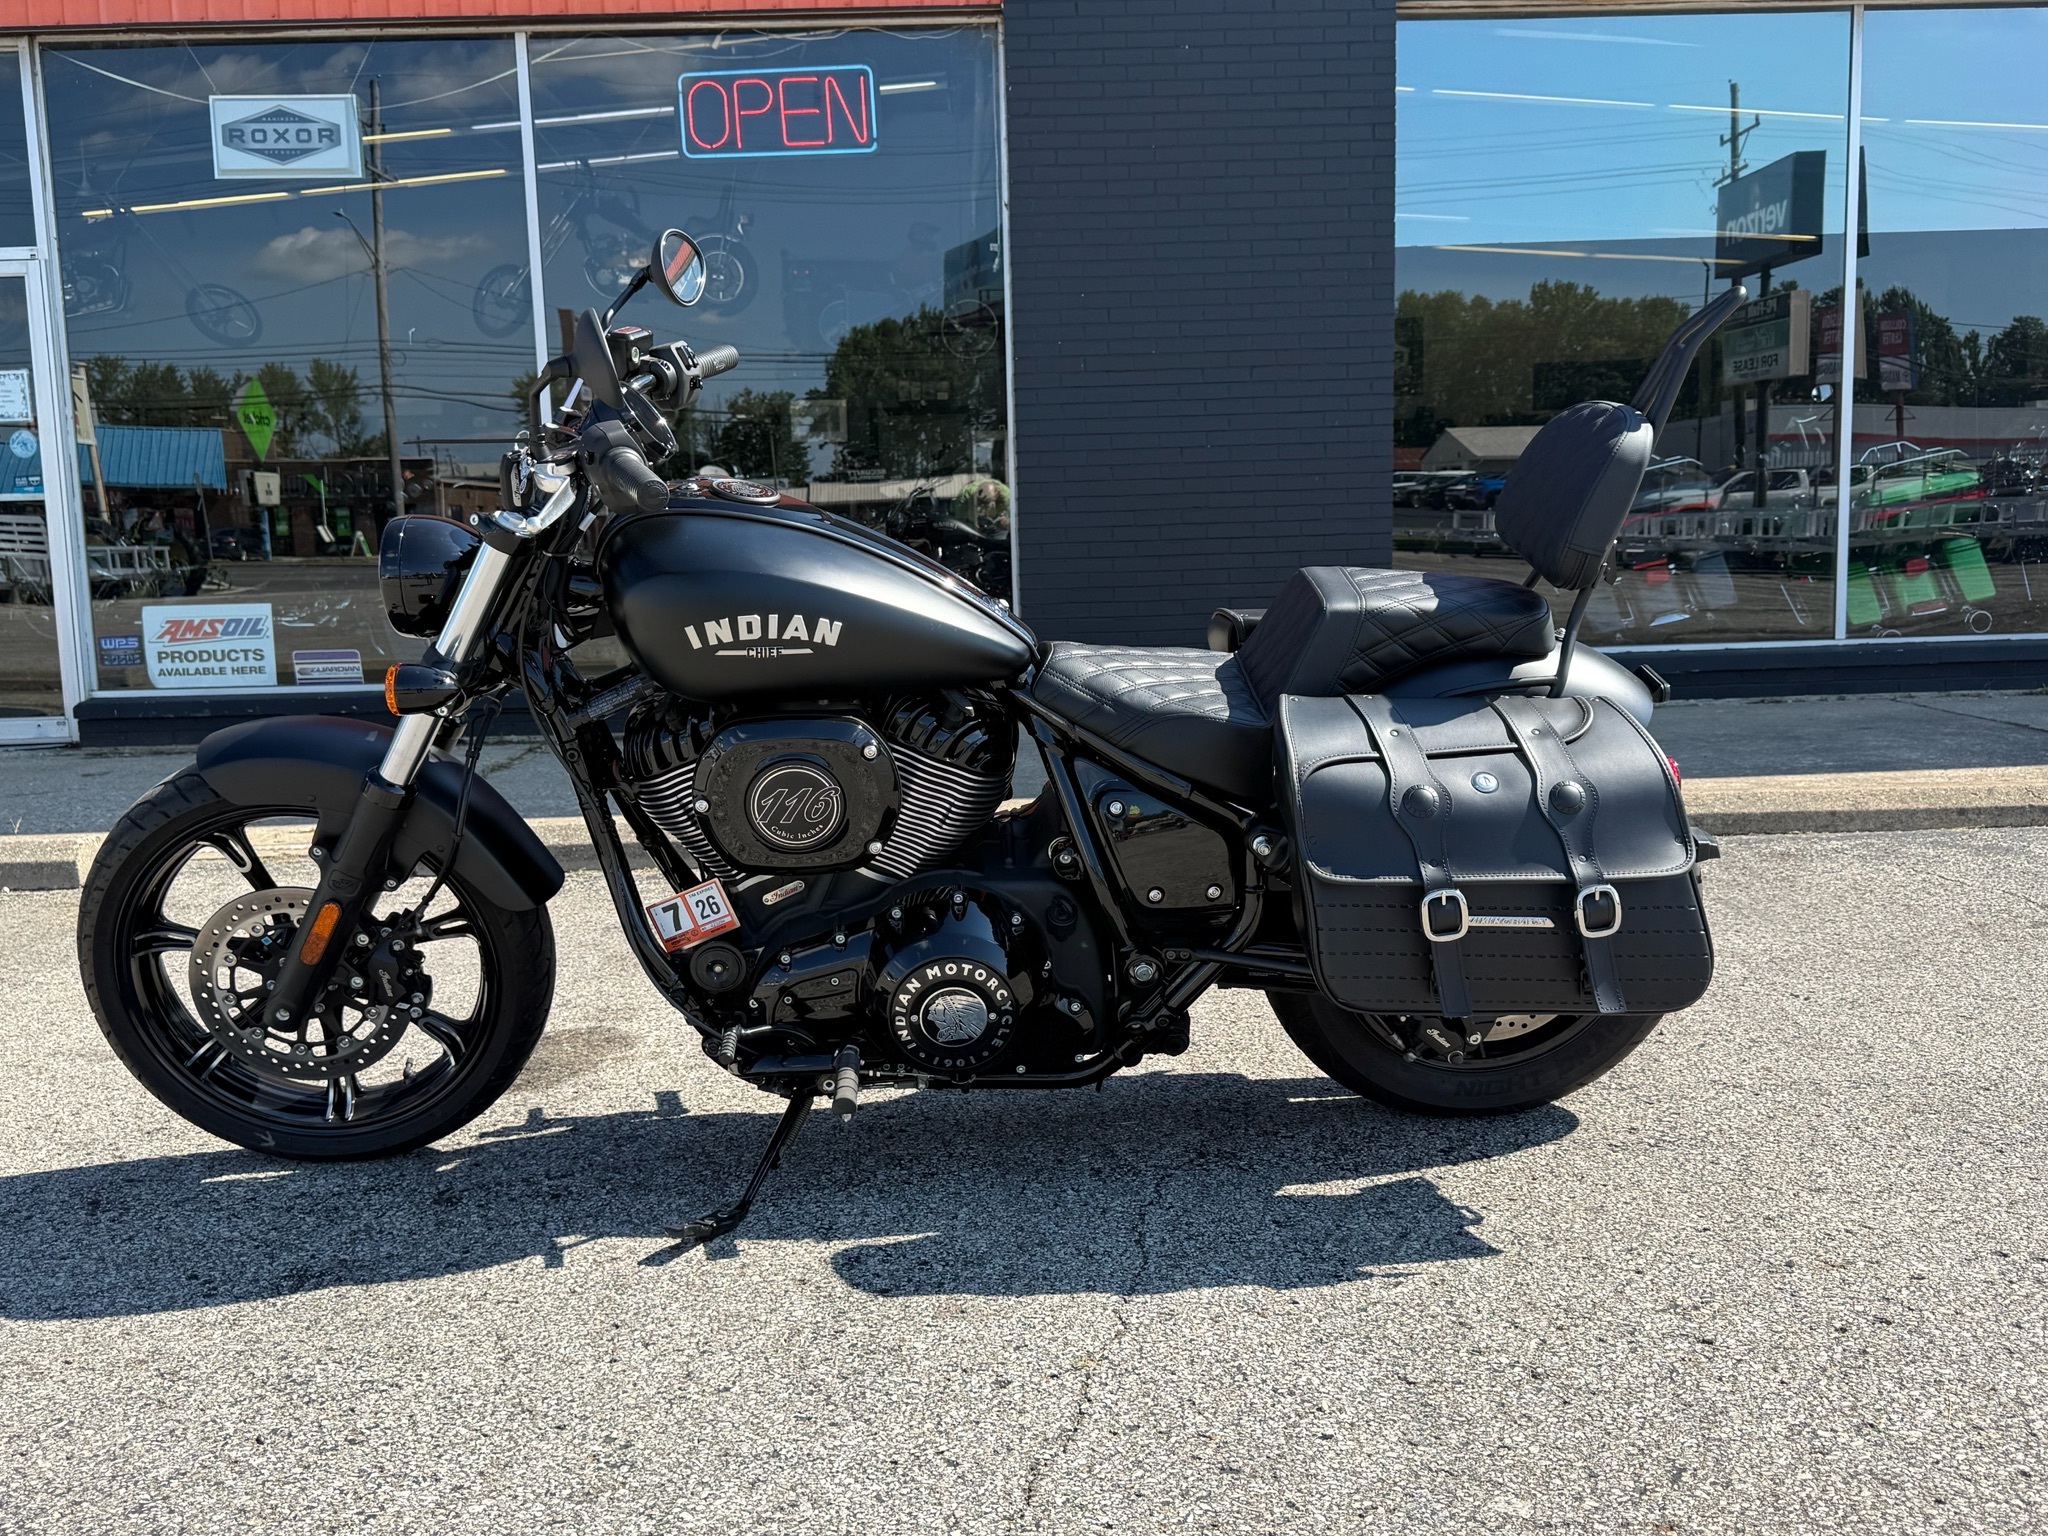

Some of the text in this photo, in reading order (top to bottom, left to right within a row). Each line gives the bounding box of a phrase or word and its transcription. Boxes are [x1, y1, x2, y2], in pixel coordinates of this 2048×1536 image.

[688, 76, 868, 149] OPEN
[228, 127, 336, 144] ROXOR
[155, 617, 267, 643] AMSOIL
[684, 614, 843, 650] INDIAN
[101, 636, 139, 649] WPS
[157, 648, 265, 664] PRODUCTS
[746, 646, 784, 658] CHIEF
[158, 665, 267, 677] AVAILABLE HERE
[757, 785, 841, 823] 116
[771, 824, 824, 839] Cubic Inches
[769, 885, 798, 902] Indian
[661, 901, 682, 932] 7
[695, 894, 721, 920] 26
[895, 963, 1013, 1050] INDIAN MOTORCYCLE
[932, 1055, 977, 1068] 1901
[1453, 1068, 1545, 1097] NIGHT
